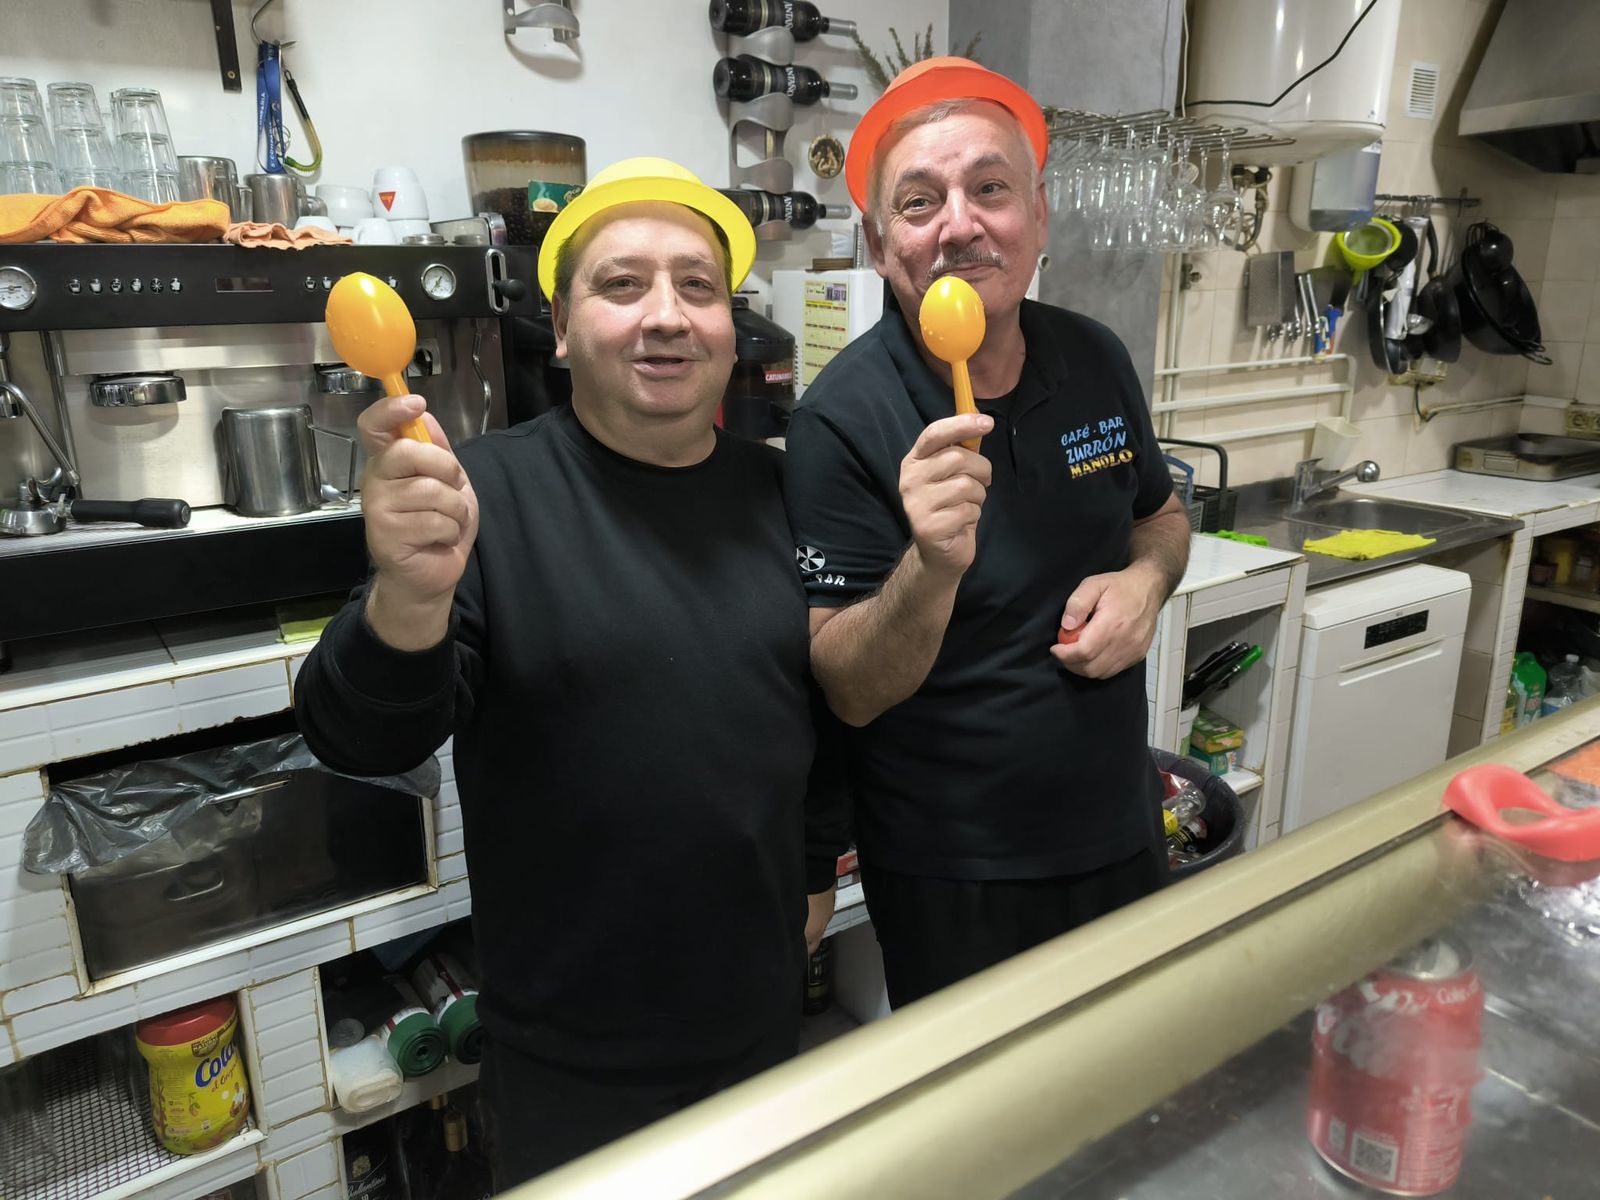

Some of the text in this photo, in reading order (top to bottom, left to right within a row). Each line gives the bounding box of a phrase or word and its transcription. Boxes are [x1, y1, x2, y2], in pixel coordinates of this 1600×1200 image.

[1098, 416, 1124, 434] BAR
[1066, 431, 1127, 464] ZURRÓN
[1069, 449, 1133, 479] MANOLO
